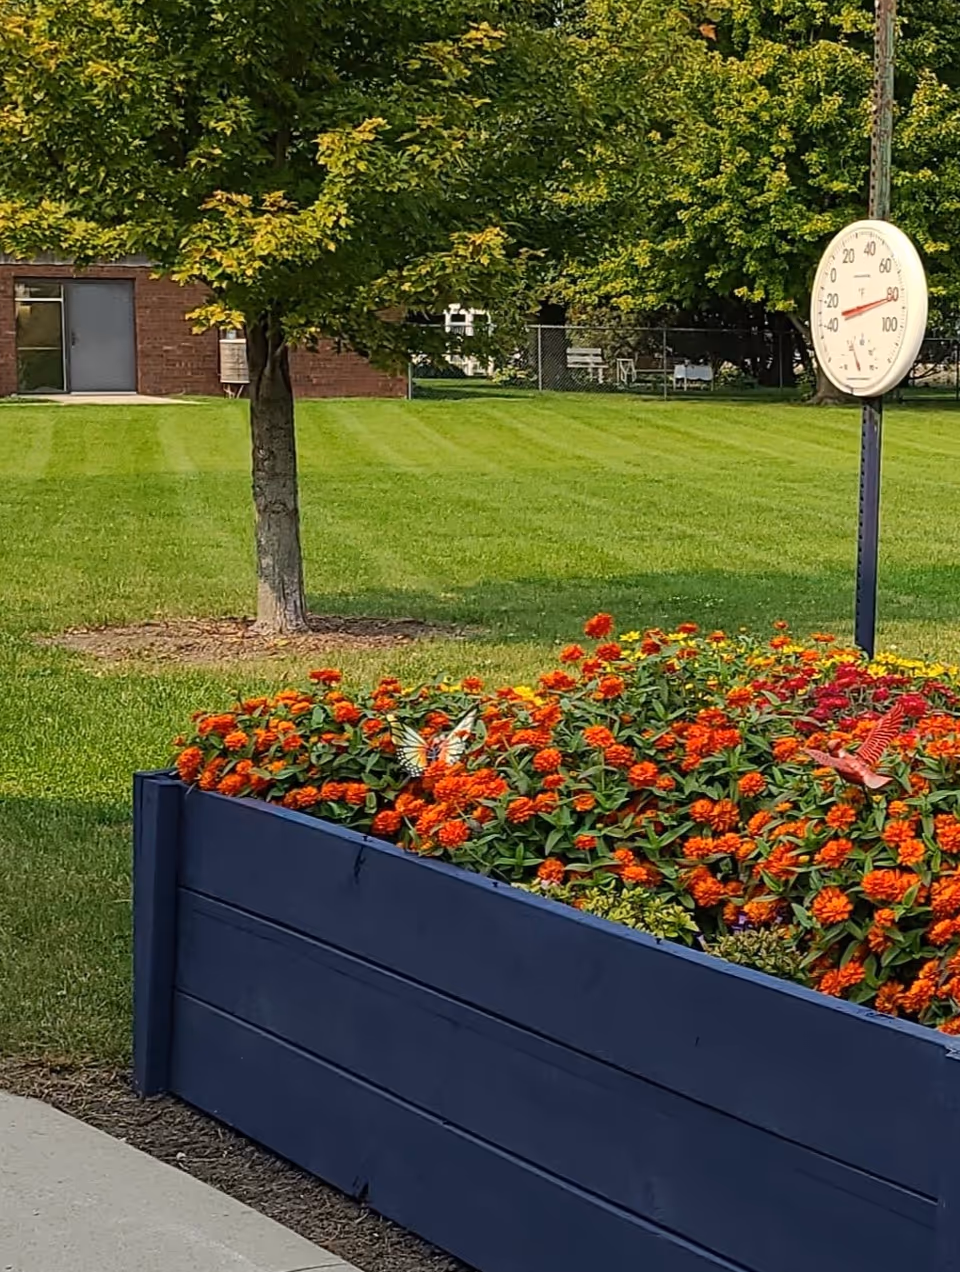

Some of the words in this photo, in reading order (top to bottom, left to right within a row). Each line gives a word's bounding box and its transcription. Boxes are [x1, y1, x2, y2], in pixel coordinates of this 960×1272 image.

[842, 248, 855, 264] 20
[863, 240, 876, 256] 40
[879, 258, 892, 273] 60
[830, 267, 837, 283] 0
[887, 286, 899, 302] 80
[882, 317, 898, 332] 100
